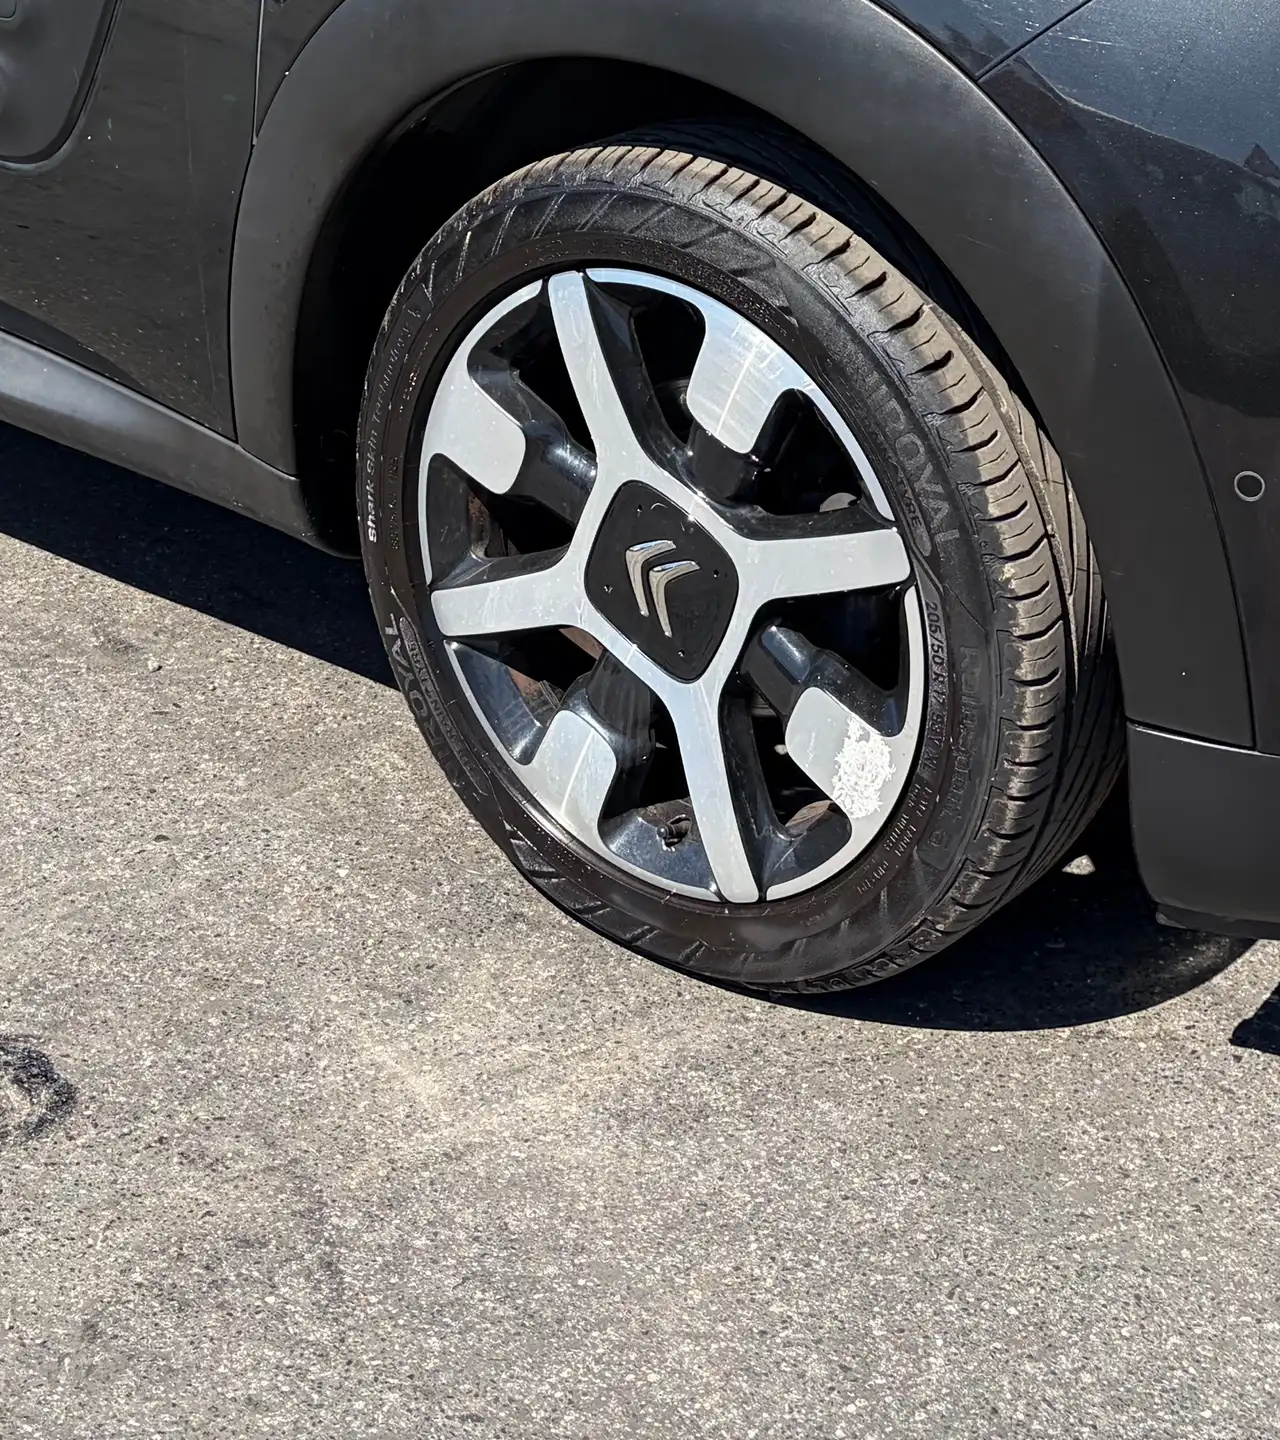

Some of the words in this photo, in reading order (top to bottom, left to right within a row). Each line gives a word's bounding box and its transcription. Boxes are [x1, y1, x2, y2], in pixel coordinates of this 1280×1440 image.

[366, 430, 378, 475] Skin
[366, 479, 377, 543] Shark
[924, 600, 946, 667] 205/50
